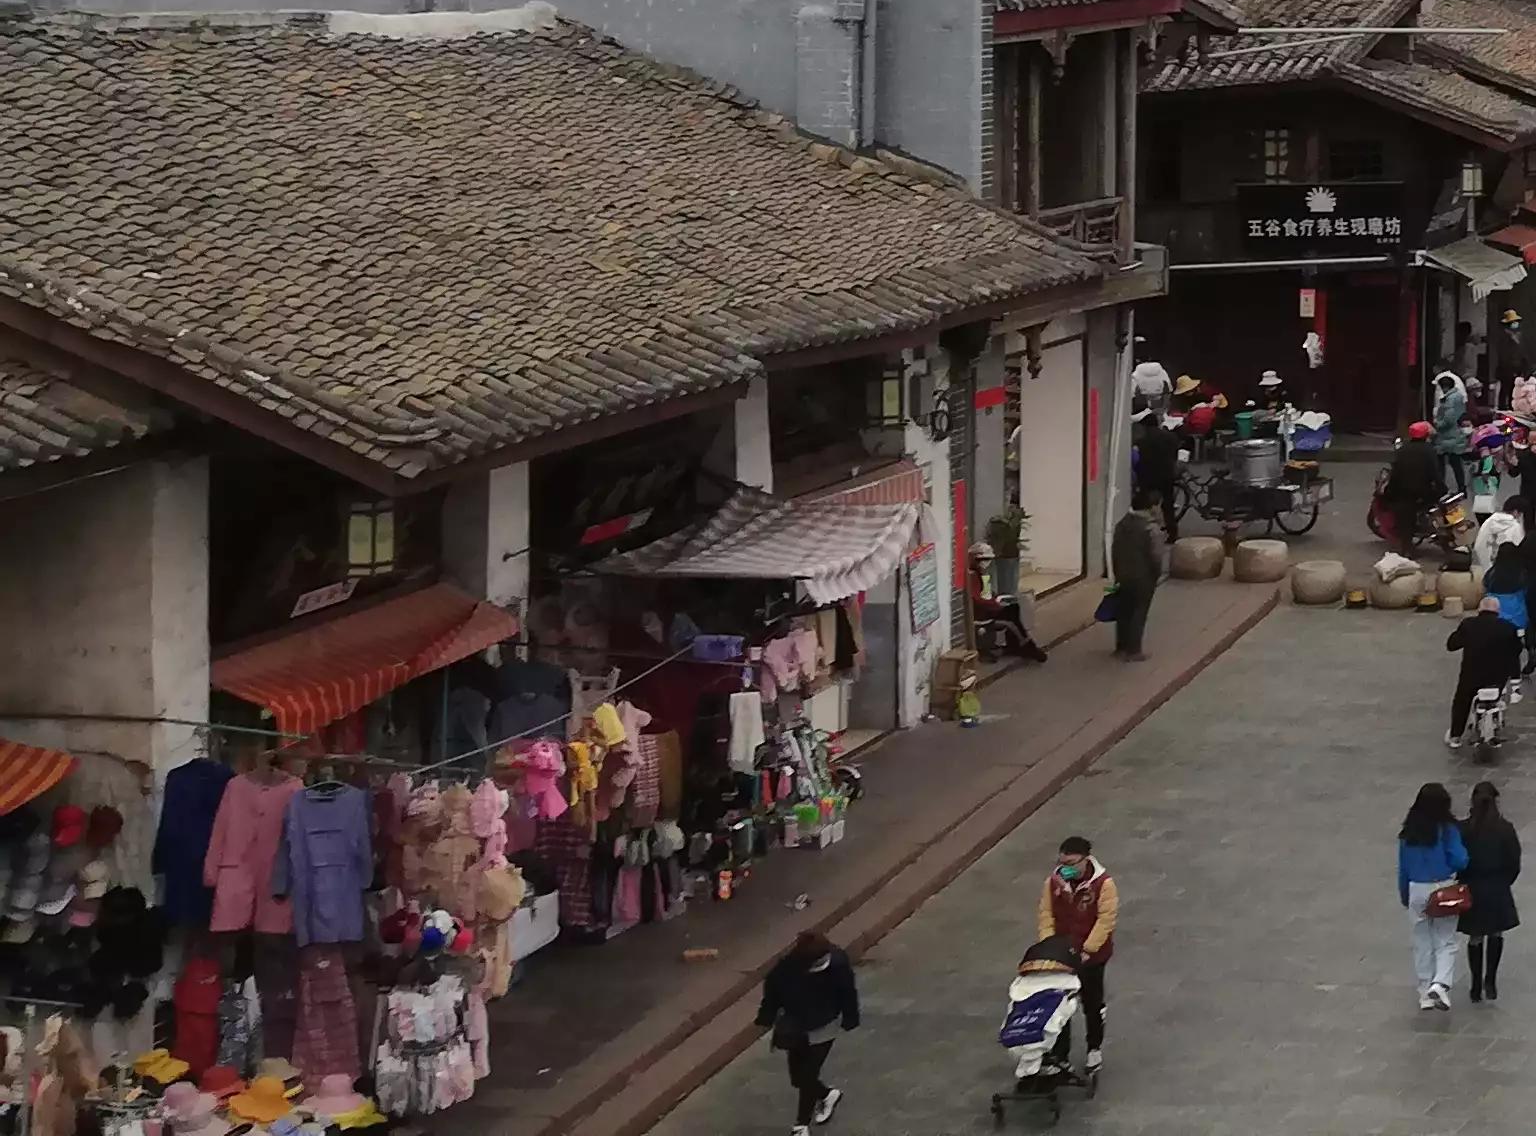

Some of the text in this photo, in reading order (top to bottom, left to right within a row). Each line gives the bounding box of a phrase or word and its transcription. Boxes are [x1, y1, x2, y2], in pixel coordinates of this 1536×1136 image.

[1247, 217, 1401, 237] 五谷食疗养生现磨坊
